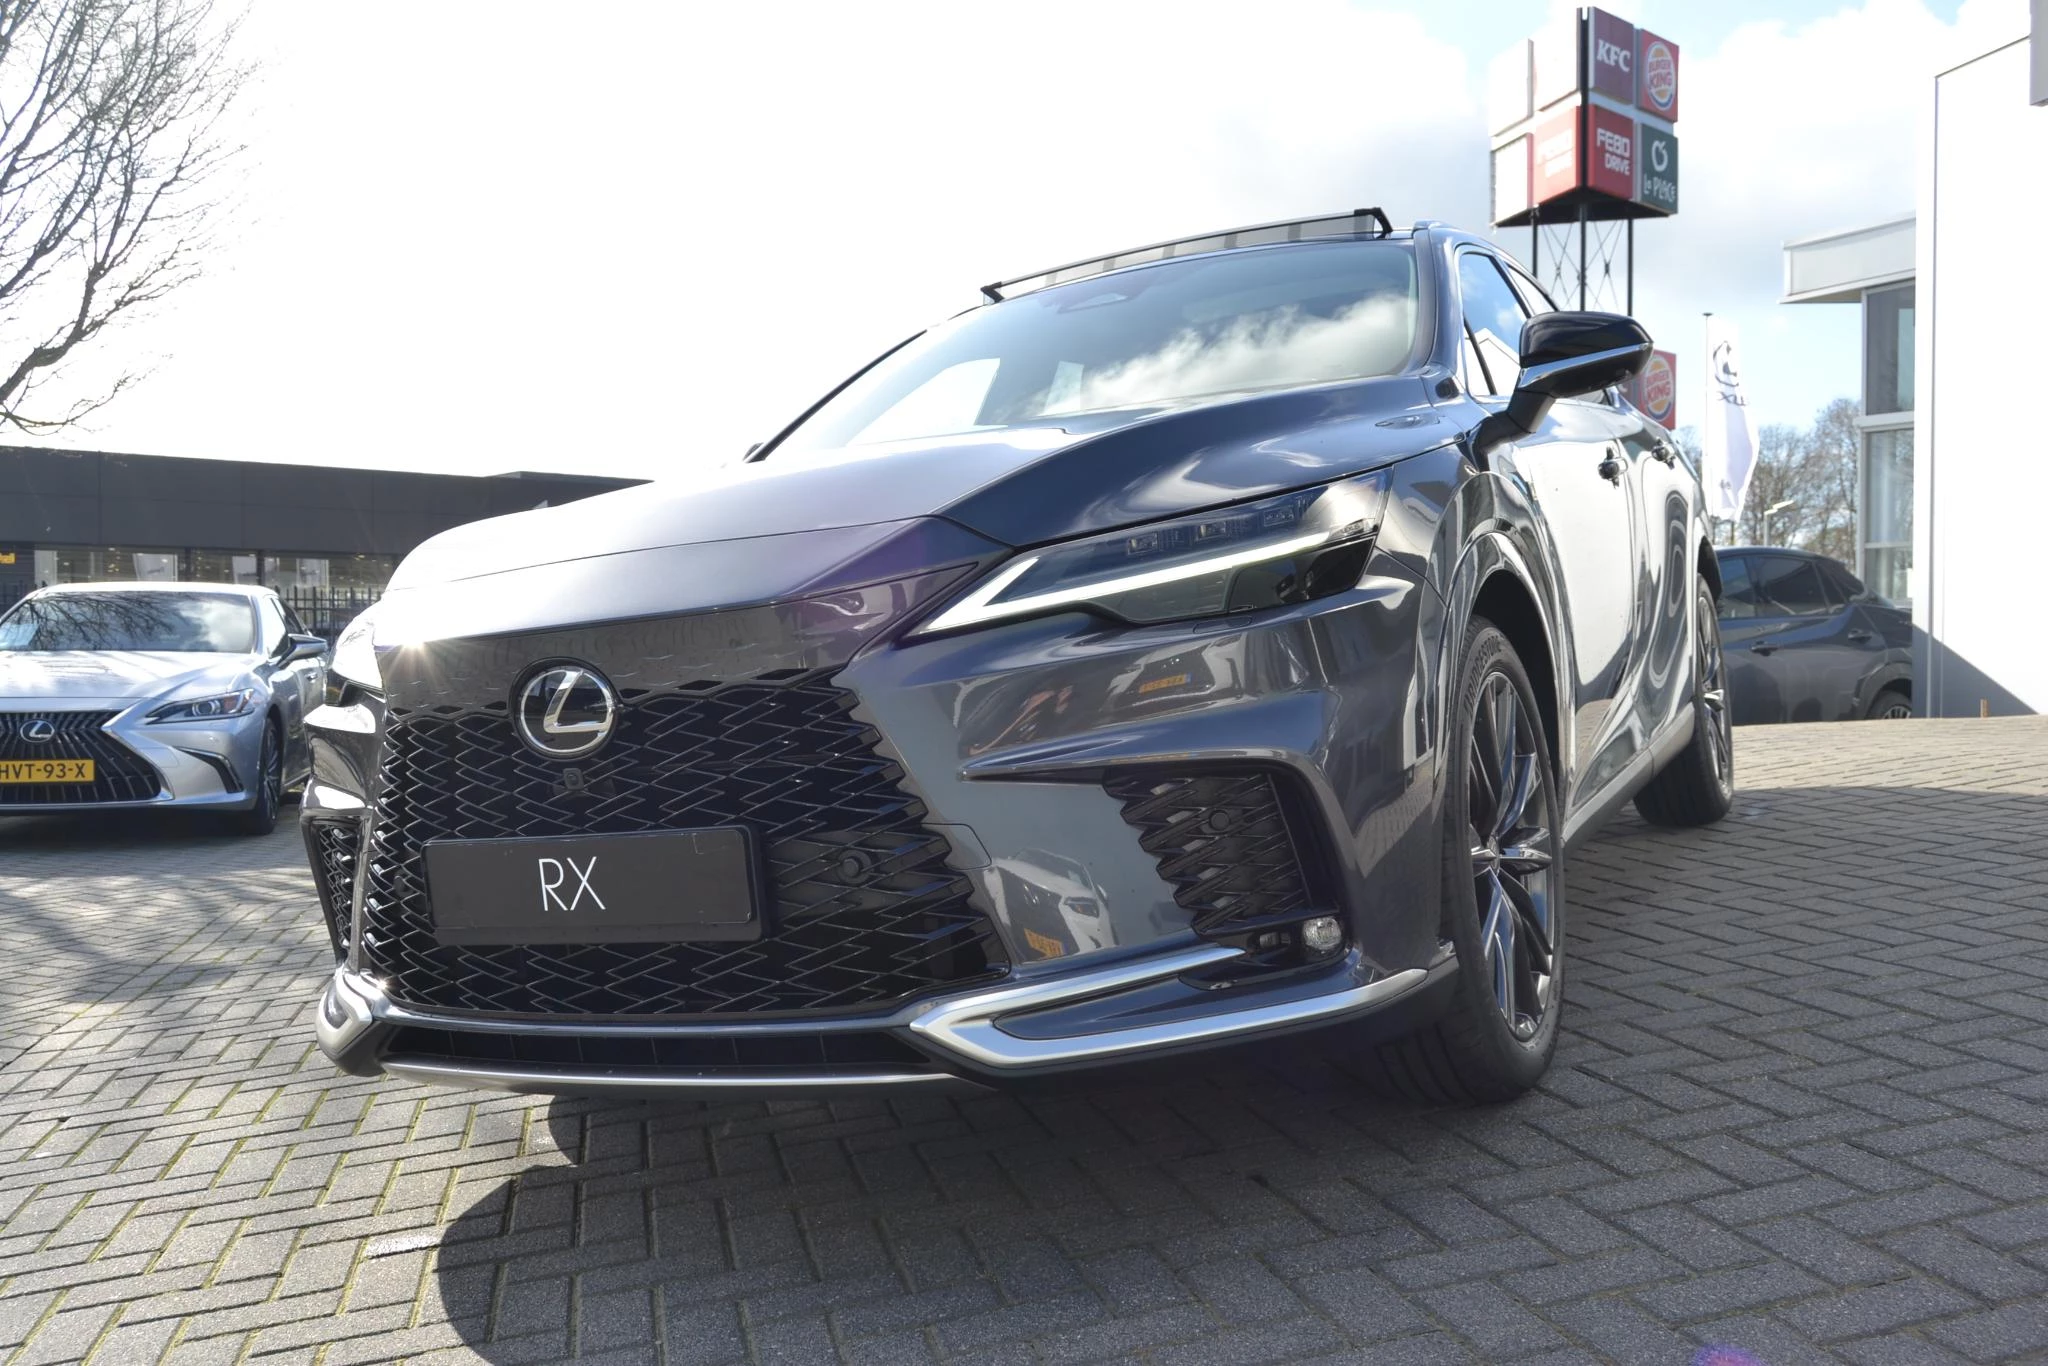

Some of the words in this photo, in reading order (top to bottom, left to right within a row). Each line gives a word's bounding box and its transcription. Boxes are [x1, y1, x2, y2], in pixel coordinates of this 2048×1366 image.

[1597, 38, 1631, 72] KFC
[1650, 71, 1672, 89] KING
[1597, 128, 1630, 157] FEBO
[1605, 153, 1630, 176] DRIVE
[1647, 381, 1671, 403] KING
[0, 762, 86, 780] HVT-93-X
[538, 856, 606, 911] RX
